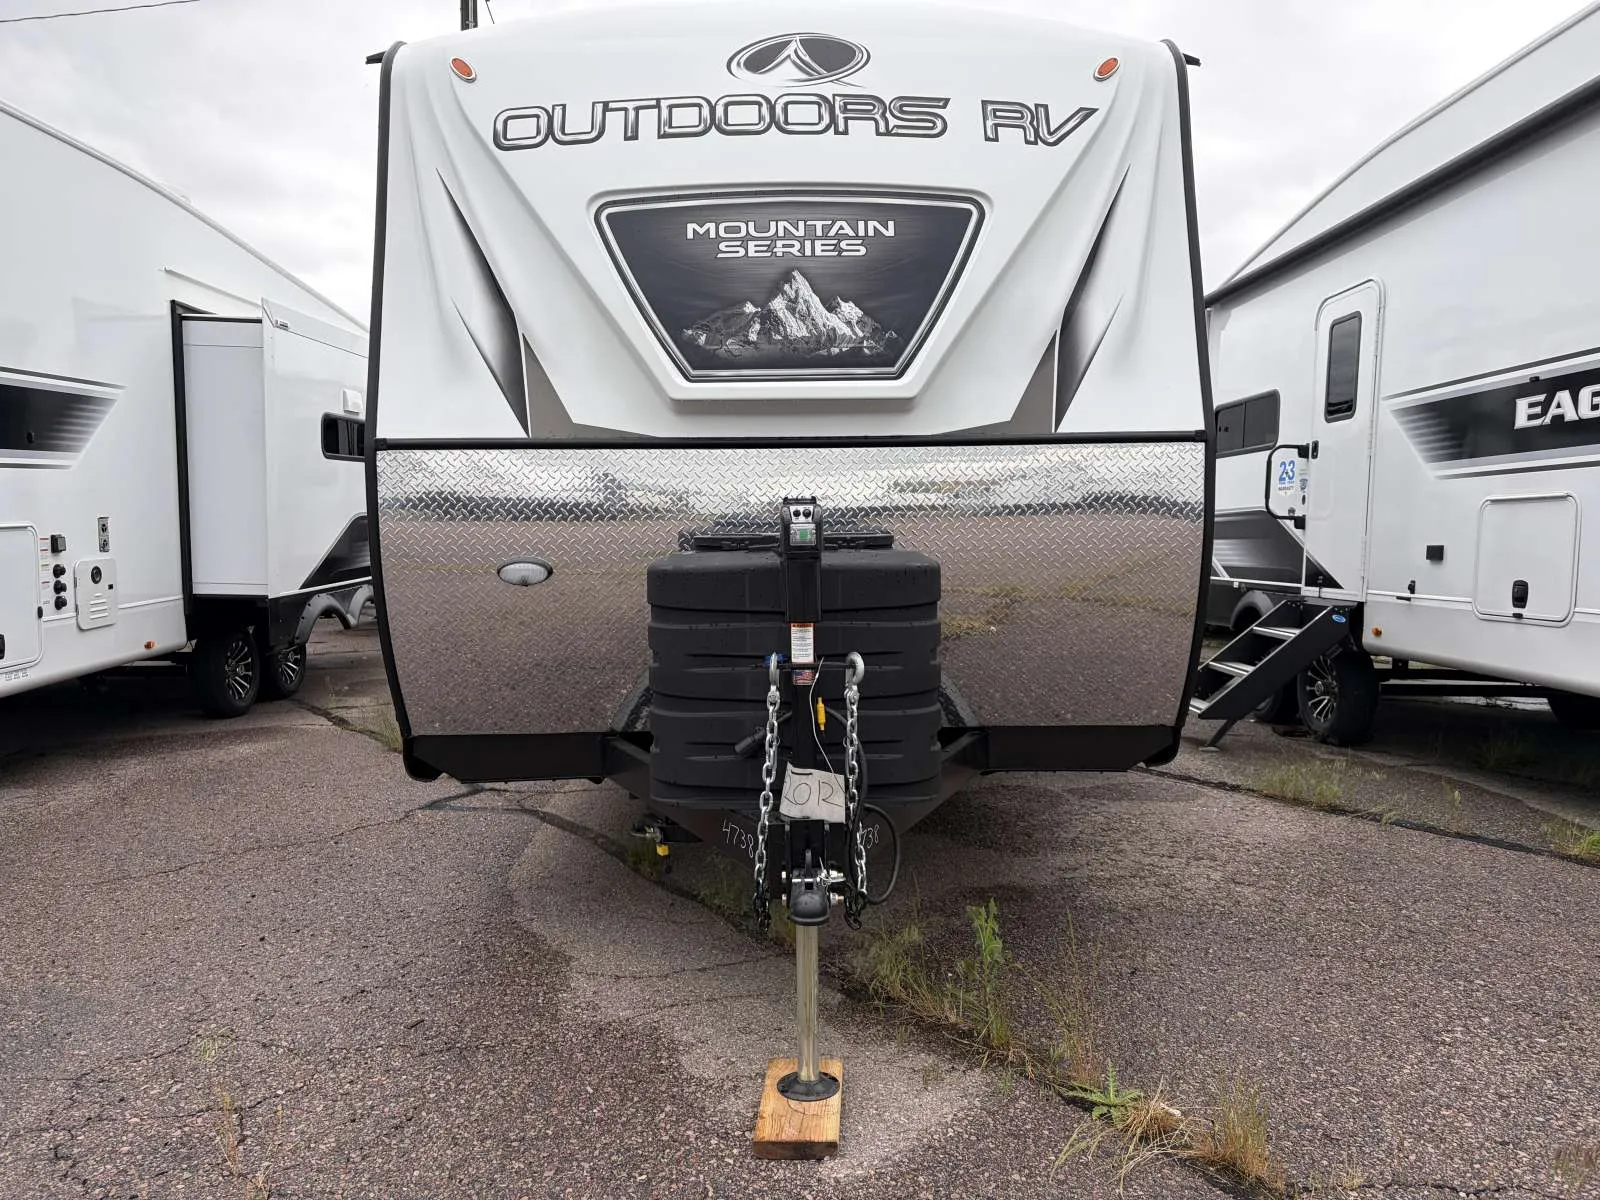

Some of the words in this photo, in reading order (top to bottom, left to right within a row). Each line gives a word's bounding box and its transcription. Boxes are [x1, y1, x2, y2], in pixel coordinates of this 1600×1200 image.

[493, 93, 951, 151] OUTDOORS
[981, 99, 1099, 147] RV
[685, 219, 896, 240] MOUNTAIN
[715, 238, 868, 259] SERIES
